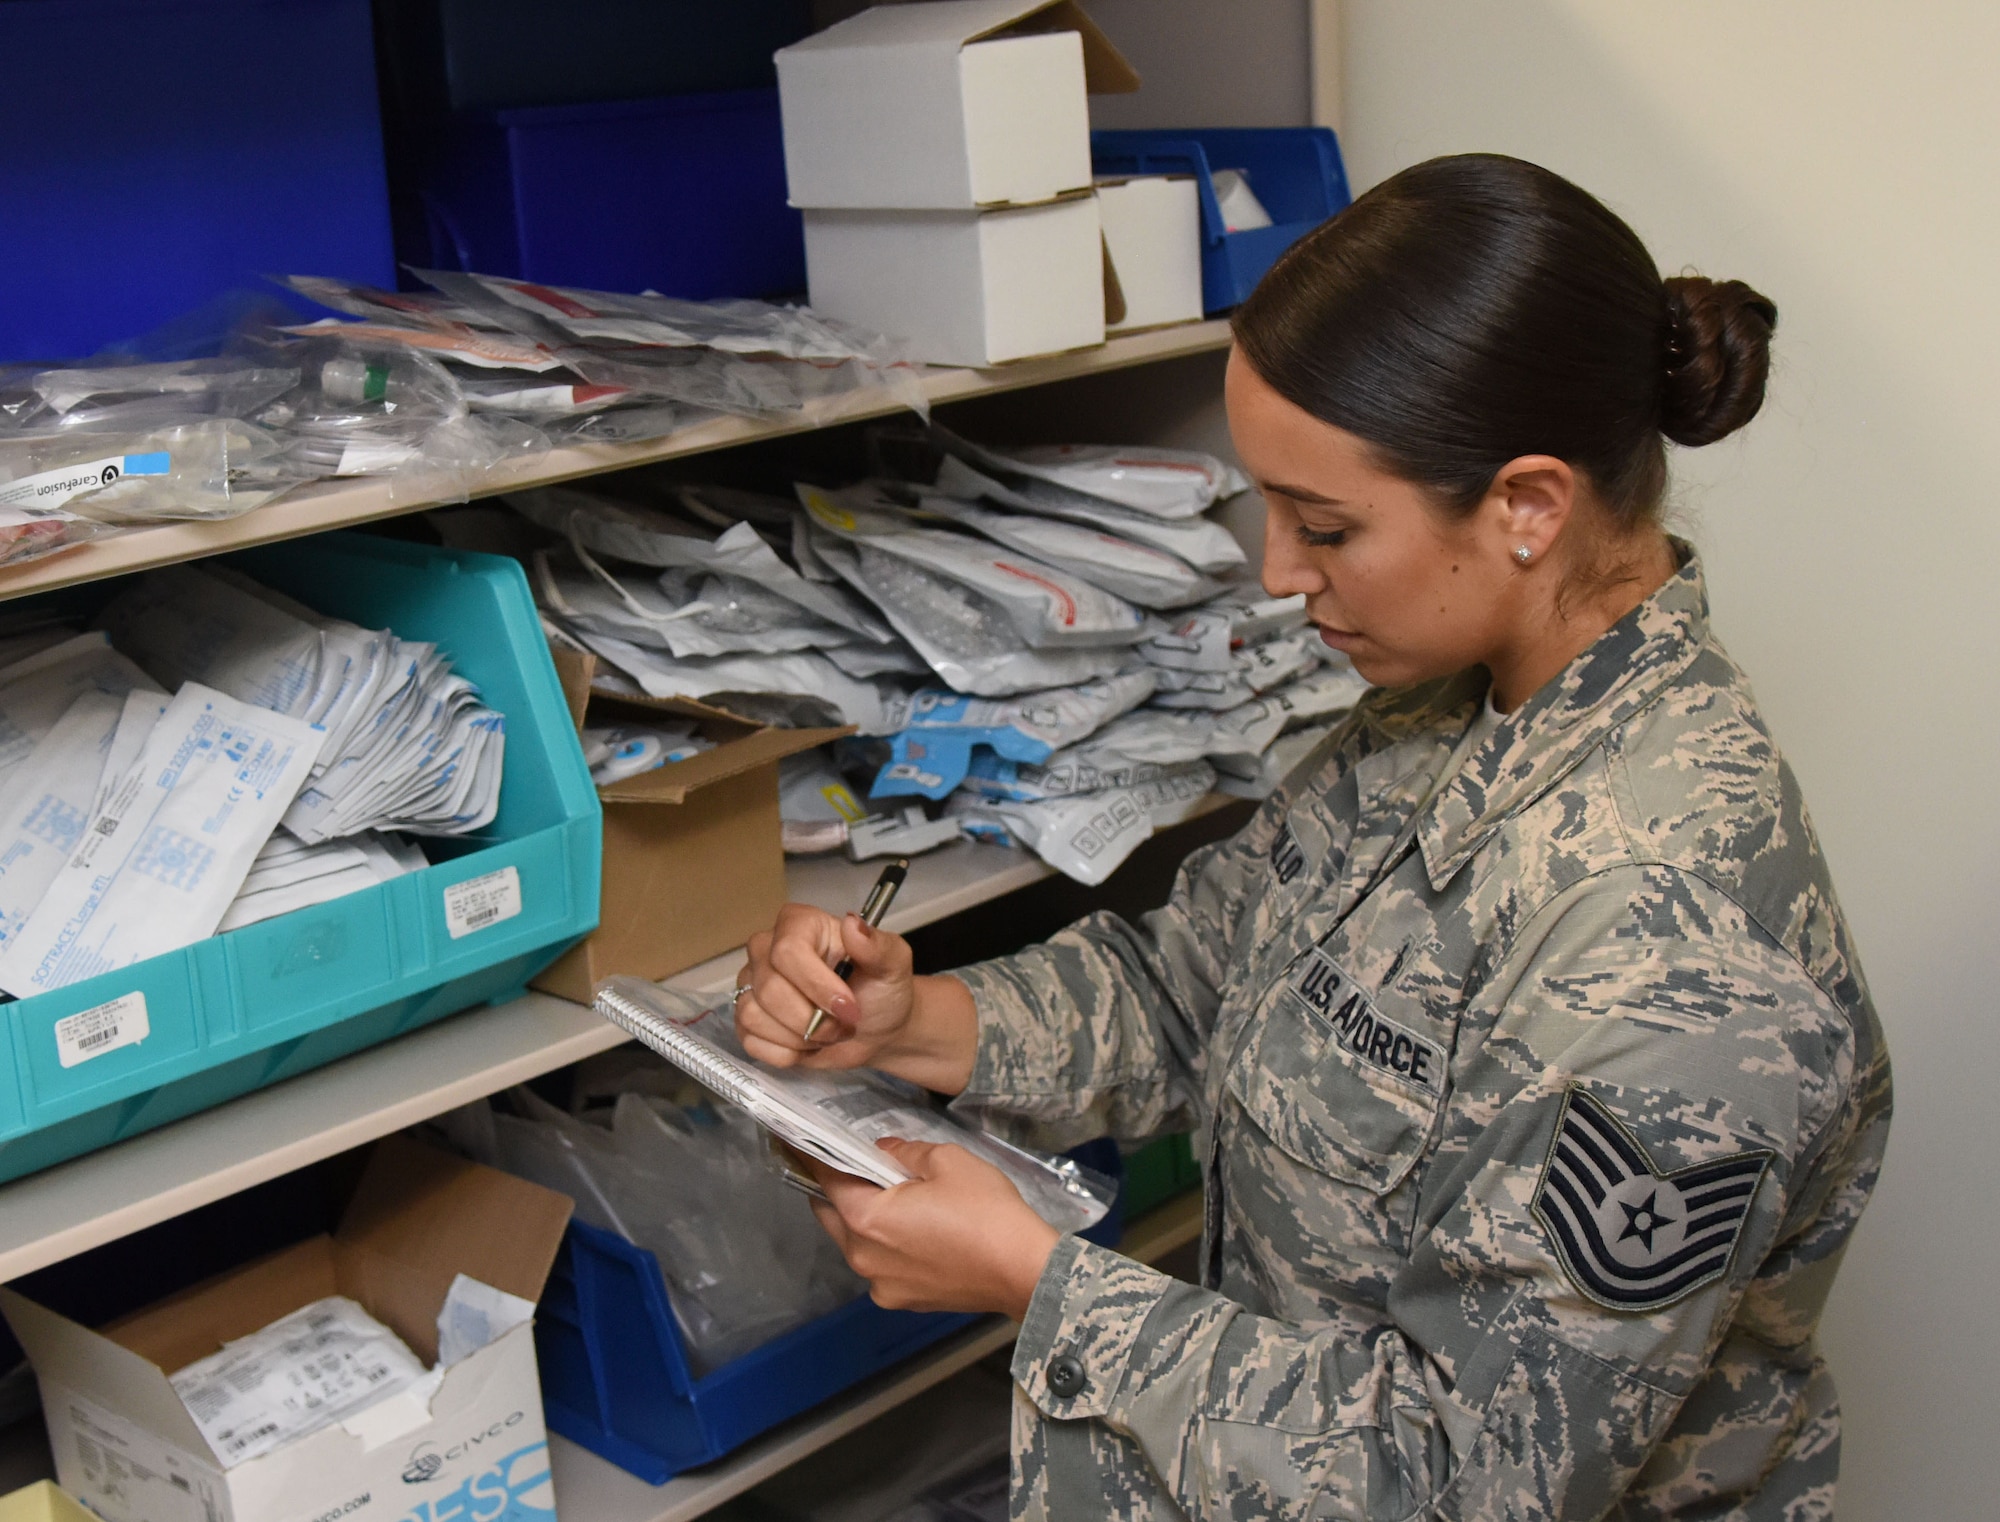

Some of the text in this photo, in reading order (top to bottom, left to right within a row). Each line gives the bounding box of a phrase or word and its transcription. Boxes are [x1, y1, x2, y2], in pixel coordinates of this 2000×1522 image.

[36, 475, 99, 497] CareFusion
[71, 893, 100, 925] Large
[1300, 959, 1341, 1015] U.S.
[445, 1411, 524, 1460] CIVCO
